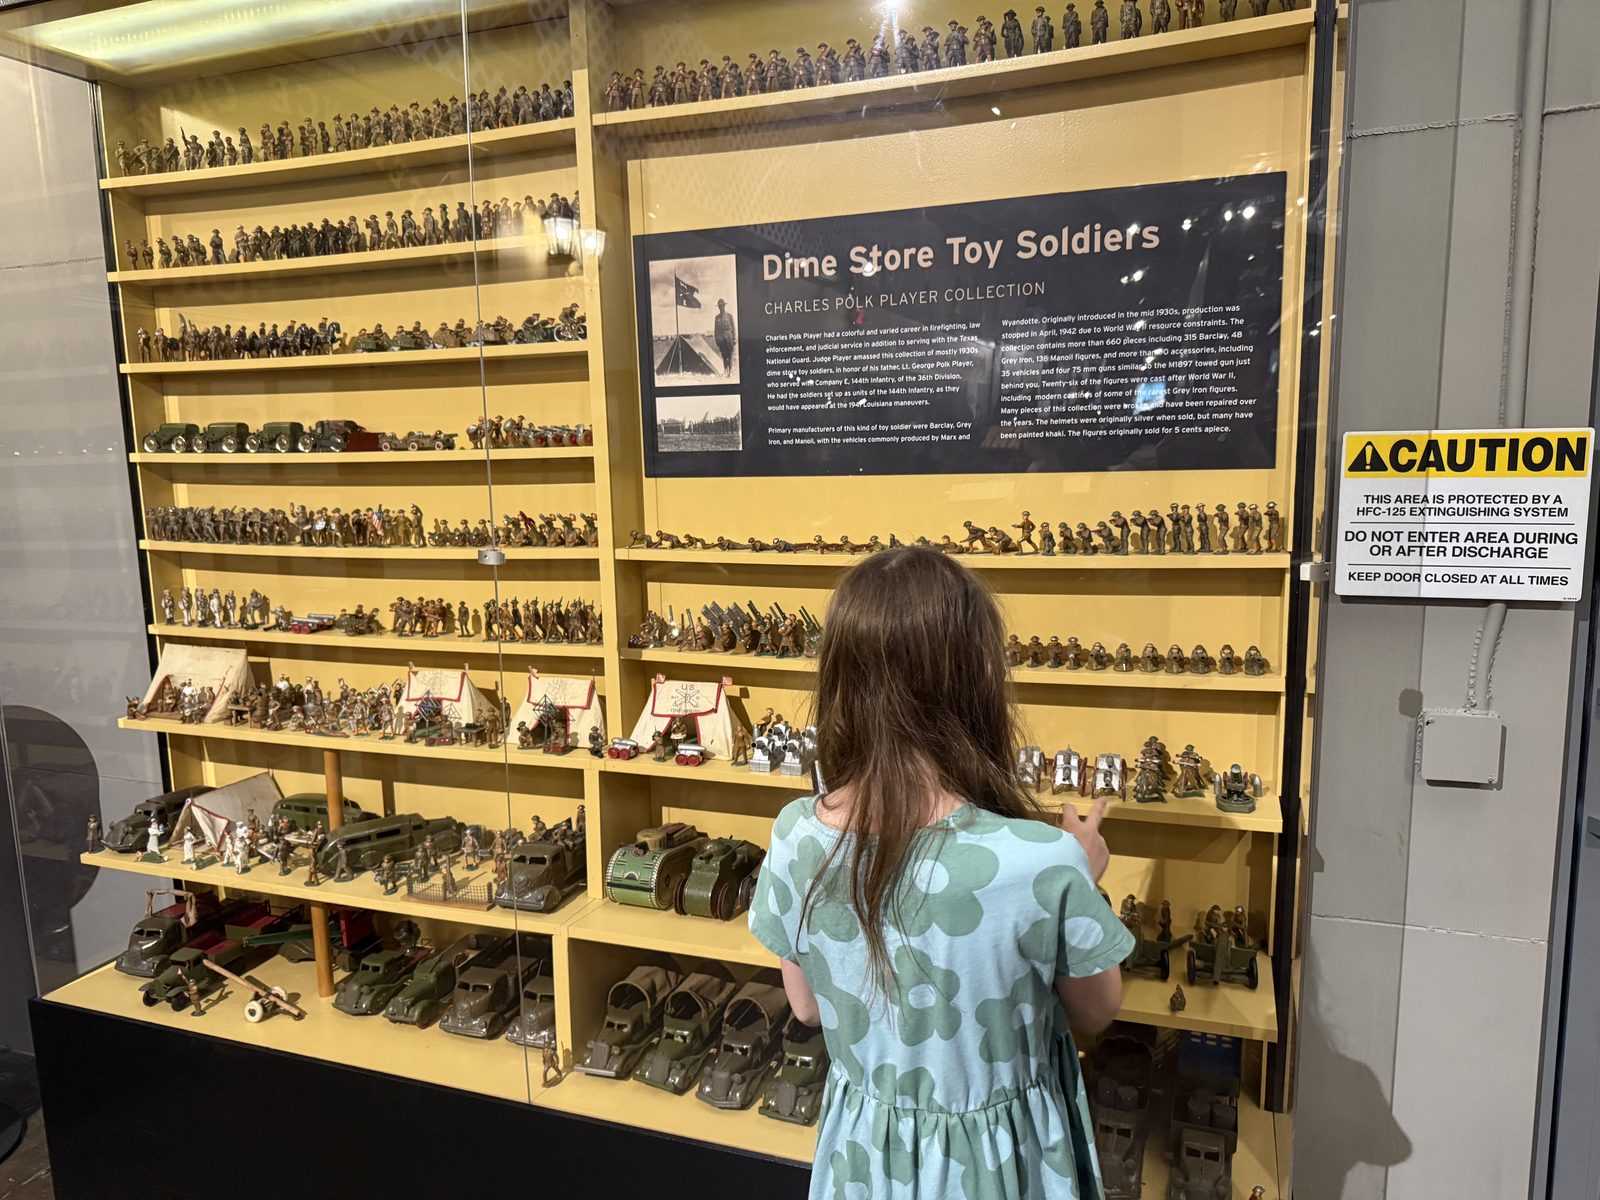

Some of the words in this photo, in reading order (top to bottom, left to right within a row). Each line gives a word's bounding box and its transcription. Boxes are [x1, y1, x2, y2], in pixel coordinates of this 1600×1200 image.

[763, 252, 837, 280] Dime
[850, 244, 934, 274] Store
[946, 236, 1003, 269] Toy
[1016, 223, 1160, 259] Soldiers
[764, 299, 830, 315] CHARLES
[836, 295, 873, 310] POLK
[880, 290, 938, 307] PLAYER
[944, 281, 1045, 301] COLLECTION
[1001, 317, 1040, 326] Wyandotte.
[1041, 314, 1075, 324] Originally
[1077, 312, 1116, 321] introduced
[1156, 308, 1180, 316] 1930s,
[1181, 305, 1223, 316] production
[841, 328, 864, 337] colorful
[879, 326, 898, 334] varied
[929, 322, 967, 331] firefighting,
[817, 342, 839, 352] judicial
[1000, 343, 1034, 351] collection
[1036, 341, 1065, 349] contains
[1122, 337, 1146, 346] pieces
[1148, 334, 1182, 343] including
[1198, 332, 1229, 340] Barclay,
[1231, 330, 1242, 338] 48
[812, 355, 831, 363] Judge
[853, 352, 880, 360] amassed
[894, 350, 925, 358] collection
[935, 348, 957, 356] mostly
[958, 346, 978, 354] 1930s
[1000, 381, 1023, 389] behind
[1041, 378, 1078, 388] Twenty-six
[1103, 377, 1128, 386] figures
[1187, 372, 1209, 380] World
[800, 402, 828, 411] appeared
[878, 424, 889, 432] toy
[929, 421, 954, 430] Barclay,
[956, 421, 971, 429] Grey
[1098, 415, 1132, 424] originally
[900, 434, 930, 443] produced
[1018, 430, 1044, 439] painted
[1082, 429, 1107, 437] figures
[1108, 427, 1143, 436] originally
[1204, 425, 1230, 433] apiece.
[1390, 438, 1587, 472] CAUTION
[1364, 495, 1392, 504] THIS
[1394, 495, 1428, 504] AREA
[1432, 495, 1444, 504] IS
[1448, 495, 1526, 504] PROTECTED
[1531, 495, 1550, 504] BY
[1553, 495, 1562, 504] A
[1357, 507, 1406, 516] HFC-125
[1410, 507, 1510, 517] EXTINGUISHING
[1513, 507, 1568, 517] SYSTEM
[1344, 531, 1366, 542] DO
[1371, 531, 1403, 543] NOT
[1407, 531, 1460, 543] ENTER
[1464, 532, 1509, 544] AREA
[1513, 532, 1578, 545] DURING
[1369, 545, 1391, 556] OR
[1396, 545, 1447, 557] AFTER
[1452, 546, 1548, 559] DISCHARGE
[1348, 572, 1381, 581] KEEP
[1384, 572, 1421, 582] DOOR
[1425, 573, 1477, 584] CLOSED
[1480, 575, 1497, 584] AT
[1499, 575, 1524, 585] ALL
[1528, 575, 1568, 586] TIMES
